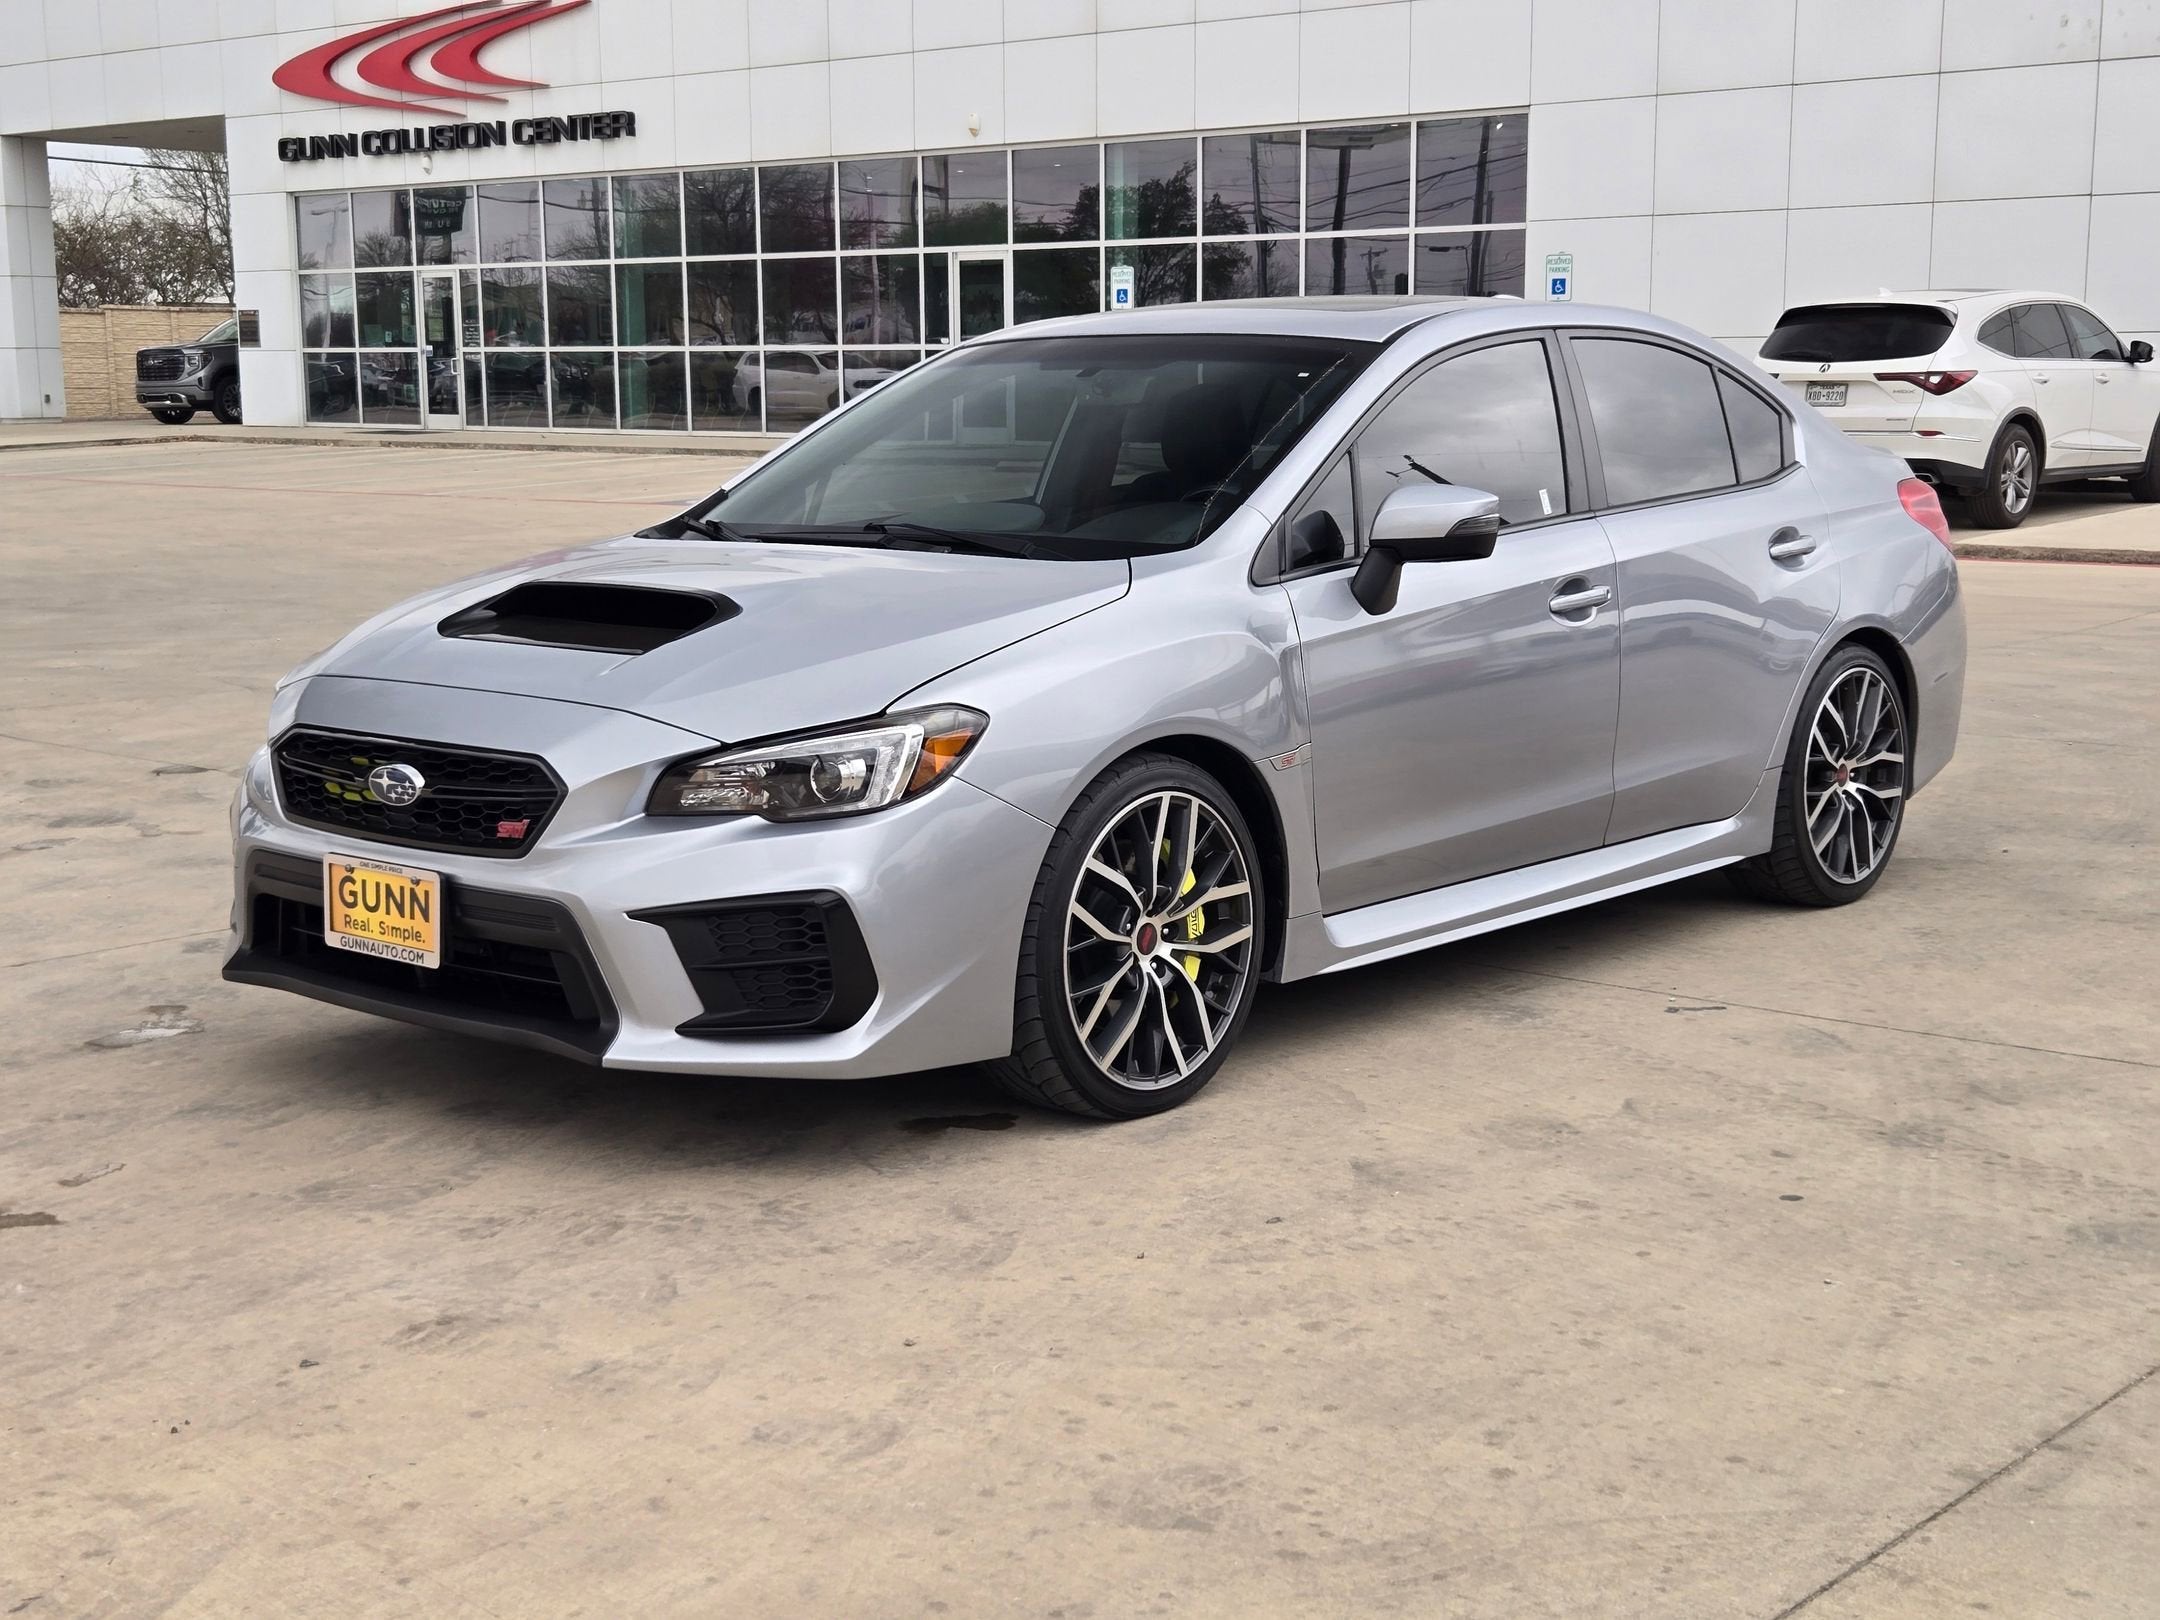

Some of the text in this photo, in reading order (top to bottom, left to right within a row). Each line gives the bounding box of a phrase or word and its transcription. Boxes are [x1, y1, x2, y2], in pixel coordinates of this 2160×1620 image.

[278, 111, 636, 161] GUNN COLLISION CENTER
[338, 875, 430, 923] GUNN
[344, 914, 374, 934] Real.
[340, 936, 425, 964] GUNNAUTO.COM
